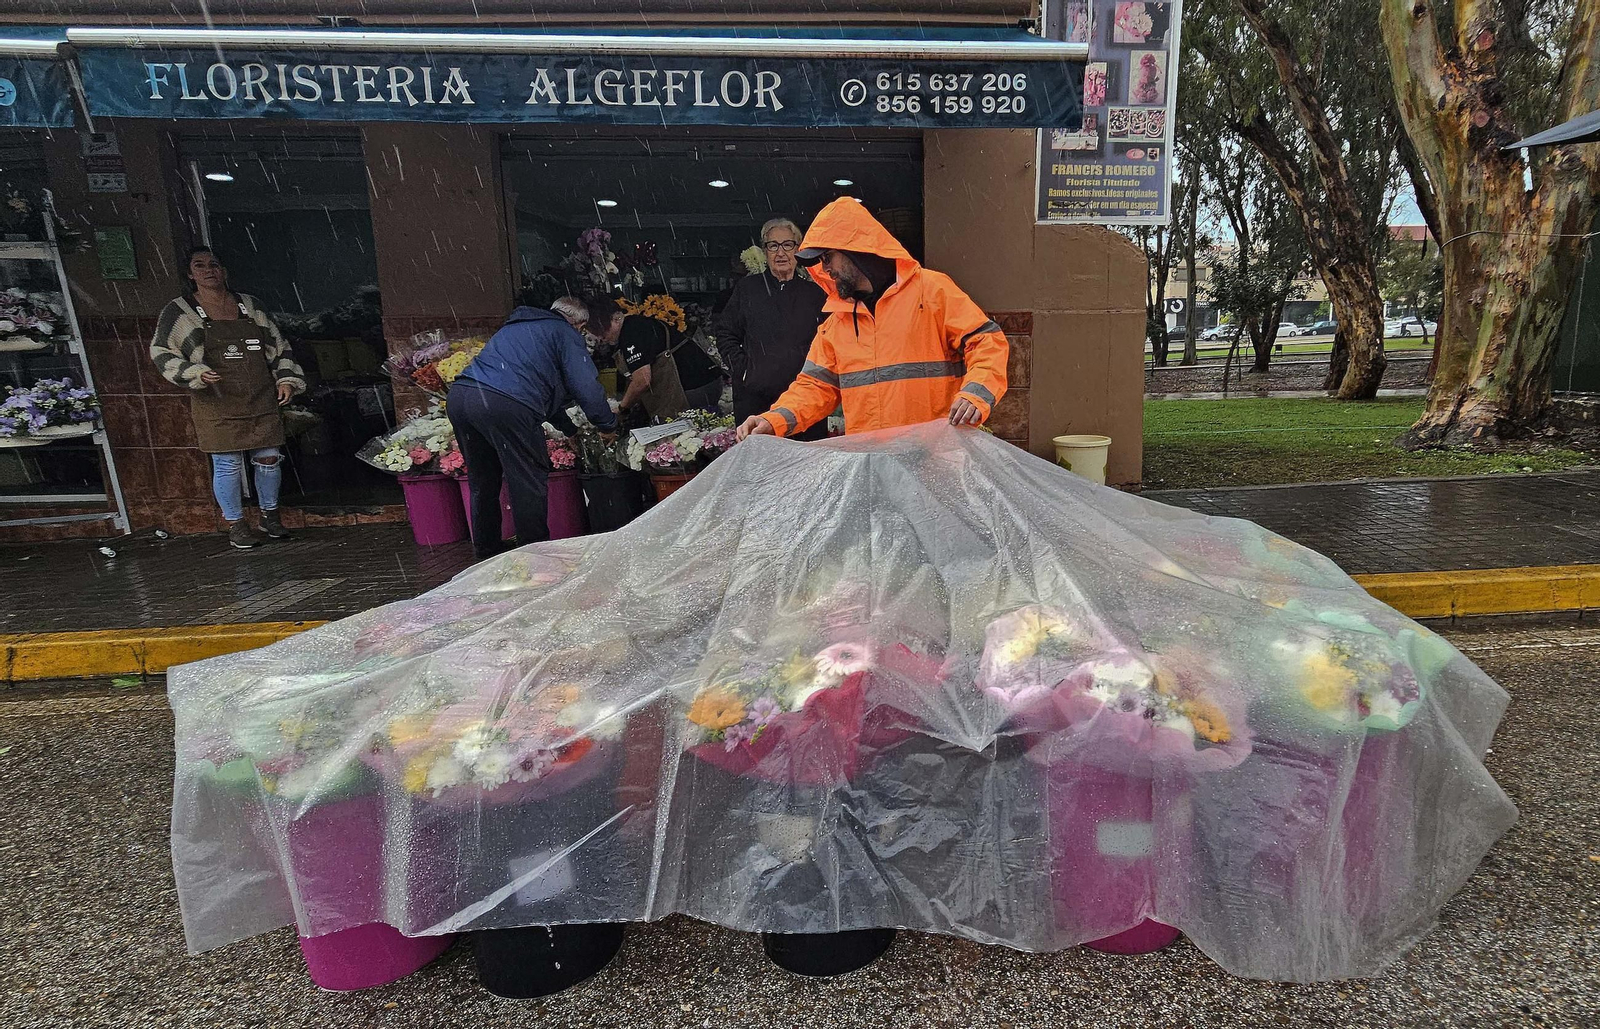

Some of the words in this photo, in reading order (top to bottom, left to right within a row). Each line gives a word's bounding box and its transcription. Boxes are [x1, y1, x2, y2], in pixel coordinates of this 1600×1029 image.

[144, 62, 476, 107] FLORISTERIA
[525, 67, 784, 112] ALGEFLOR
[876, 72, 922, 91] 615
[929, 73, 974, 91] 637
[982, 73, 1027, 91] 206
[876, 95, 921, 113] 856
[930, 95, 973, 113] 159
[982, 96, 1026, 113] 920
[1051, 164, 1103, 176] FRANCIS
[1105, 164, 1156, 176] ROMERO
[1066, 178, 1100, 186] Florista
[1102, 178, 1140, 187] Titulado
[1048, 188, 1070, 197] Ramos
[1125, 189, 1158, 199] originales
[1100, 201, 1109, 209] en
[1130, 201, 1158, 210] especial
